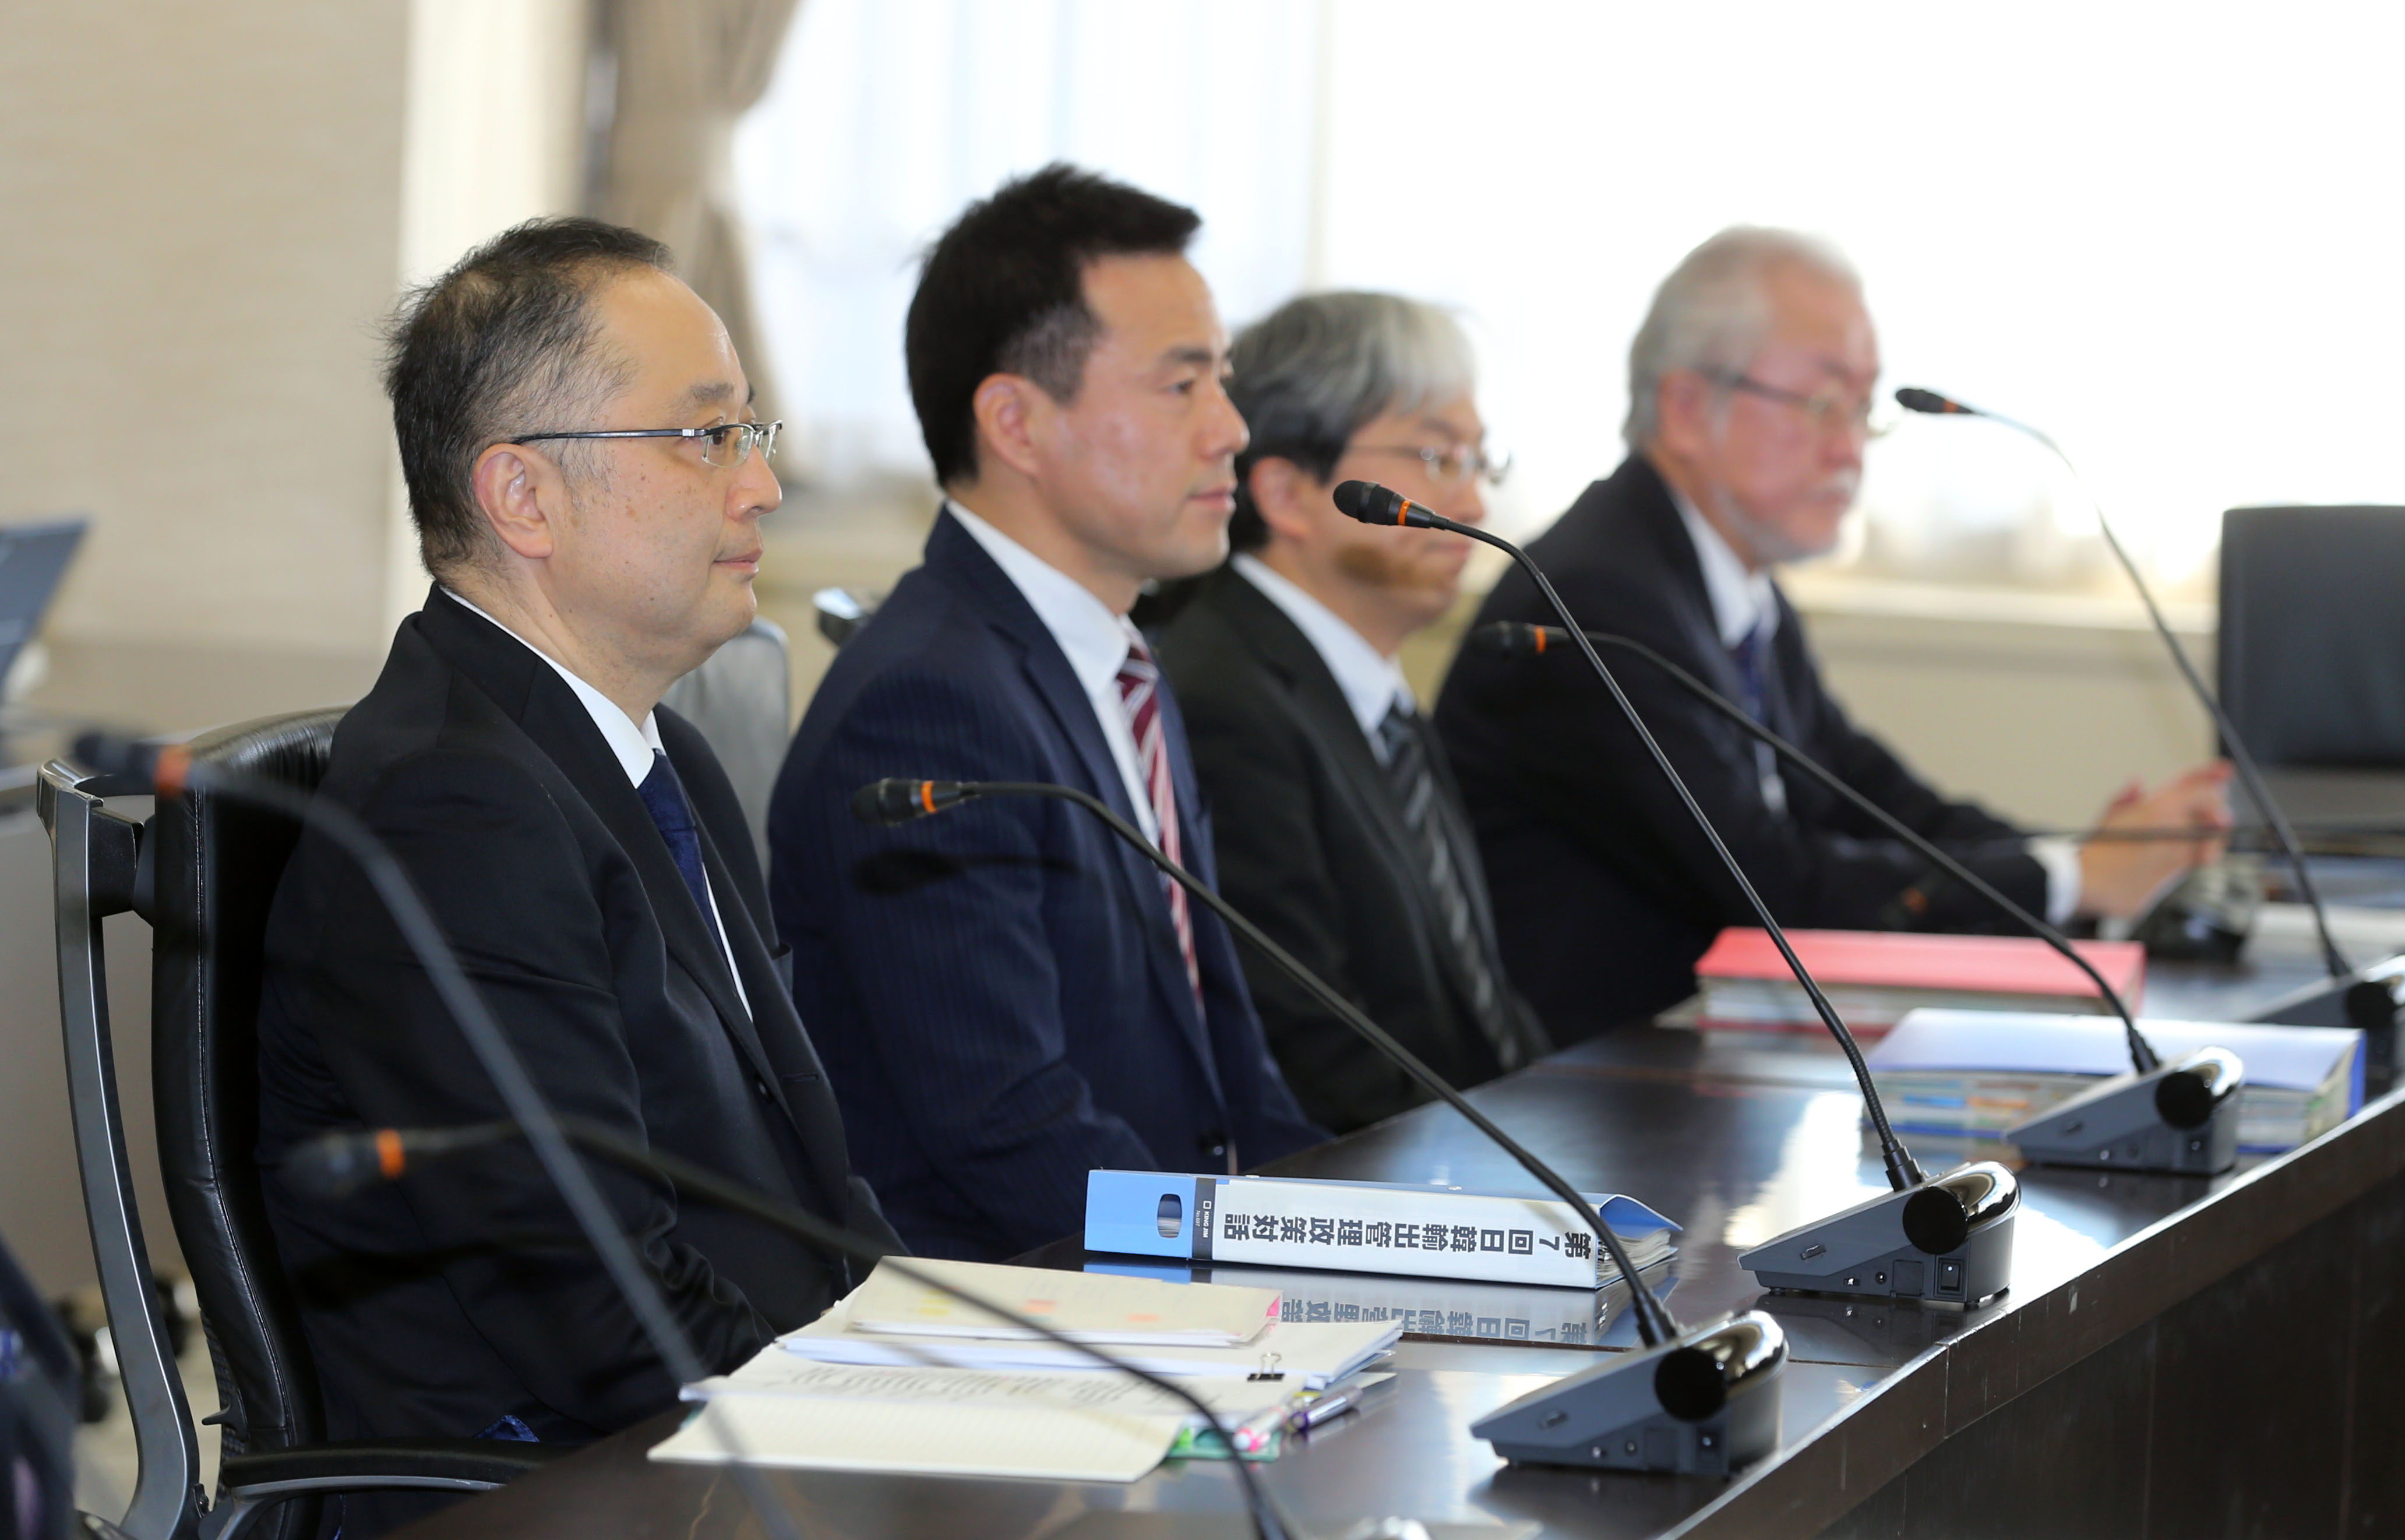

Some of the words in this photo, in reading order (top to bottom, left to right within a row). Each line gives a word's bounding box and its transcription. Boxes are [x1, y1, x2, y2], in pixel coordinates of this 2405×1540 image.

[1223, 1213, 1592, 1260] 第7回日韓輸出管理政策対話
